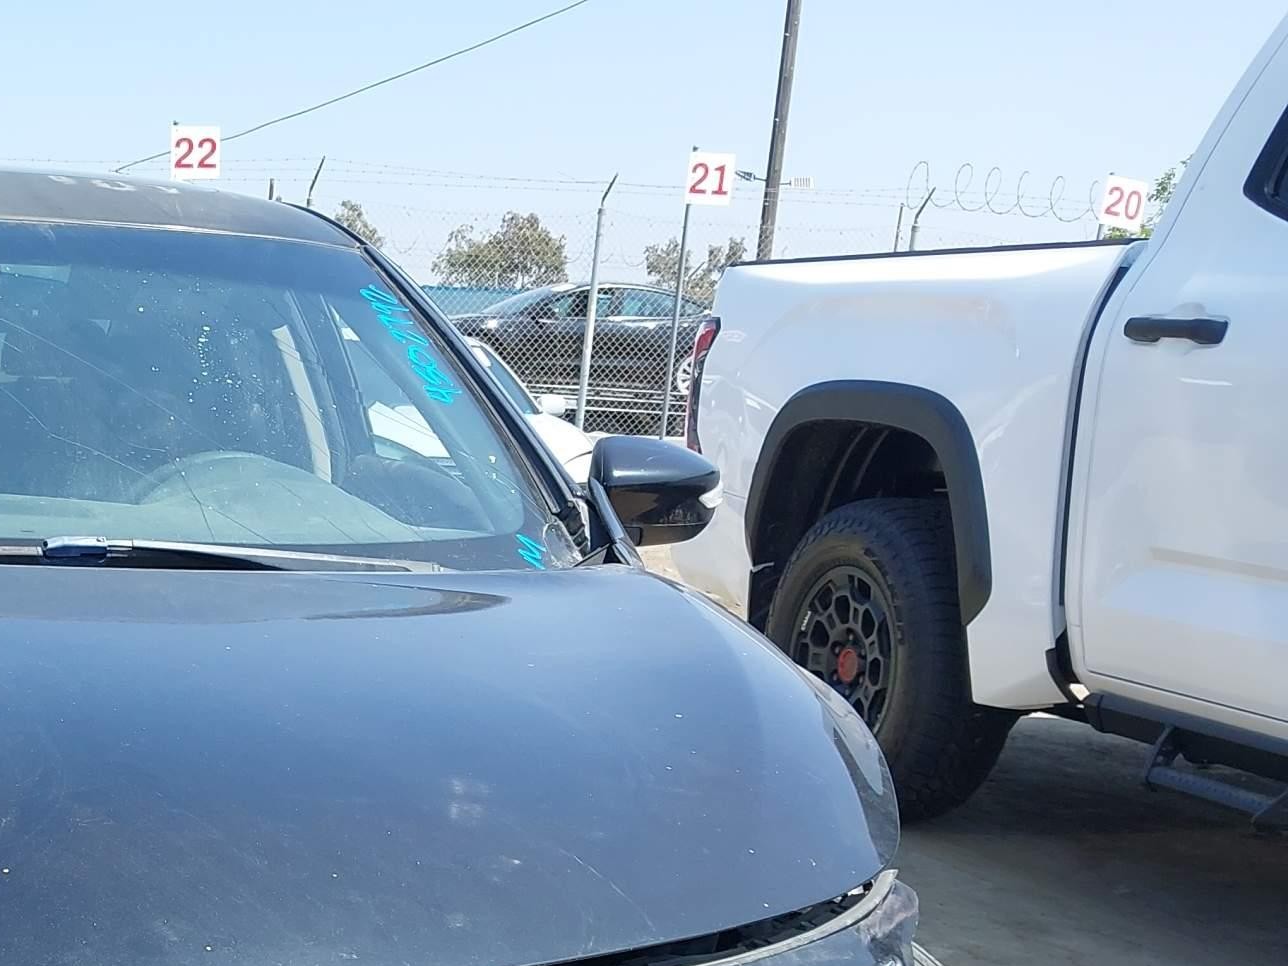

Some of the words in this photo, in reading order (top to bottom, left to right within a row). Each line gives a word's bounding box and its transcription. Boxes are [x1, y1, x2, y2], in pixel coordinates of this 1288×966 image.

[174, 137, 216, 168] 22
[689, 162, 727, 195] 21
[1106, 187, 1143, 220] 20
